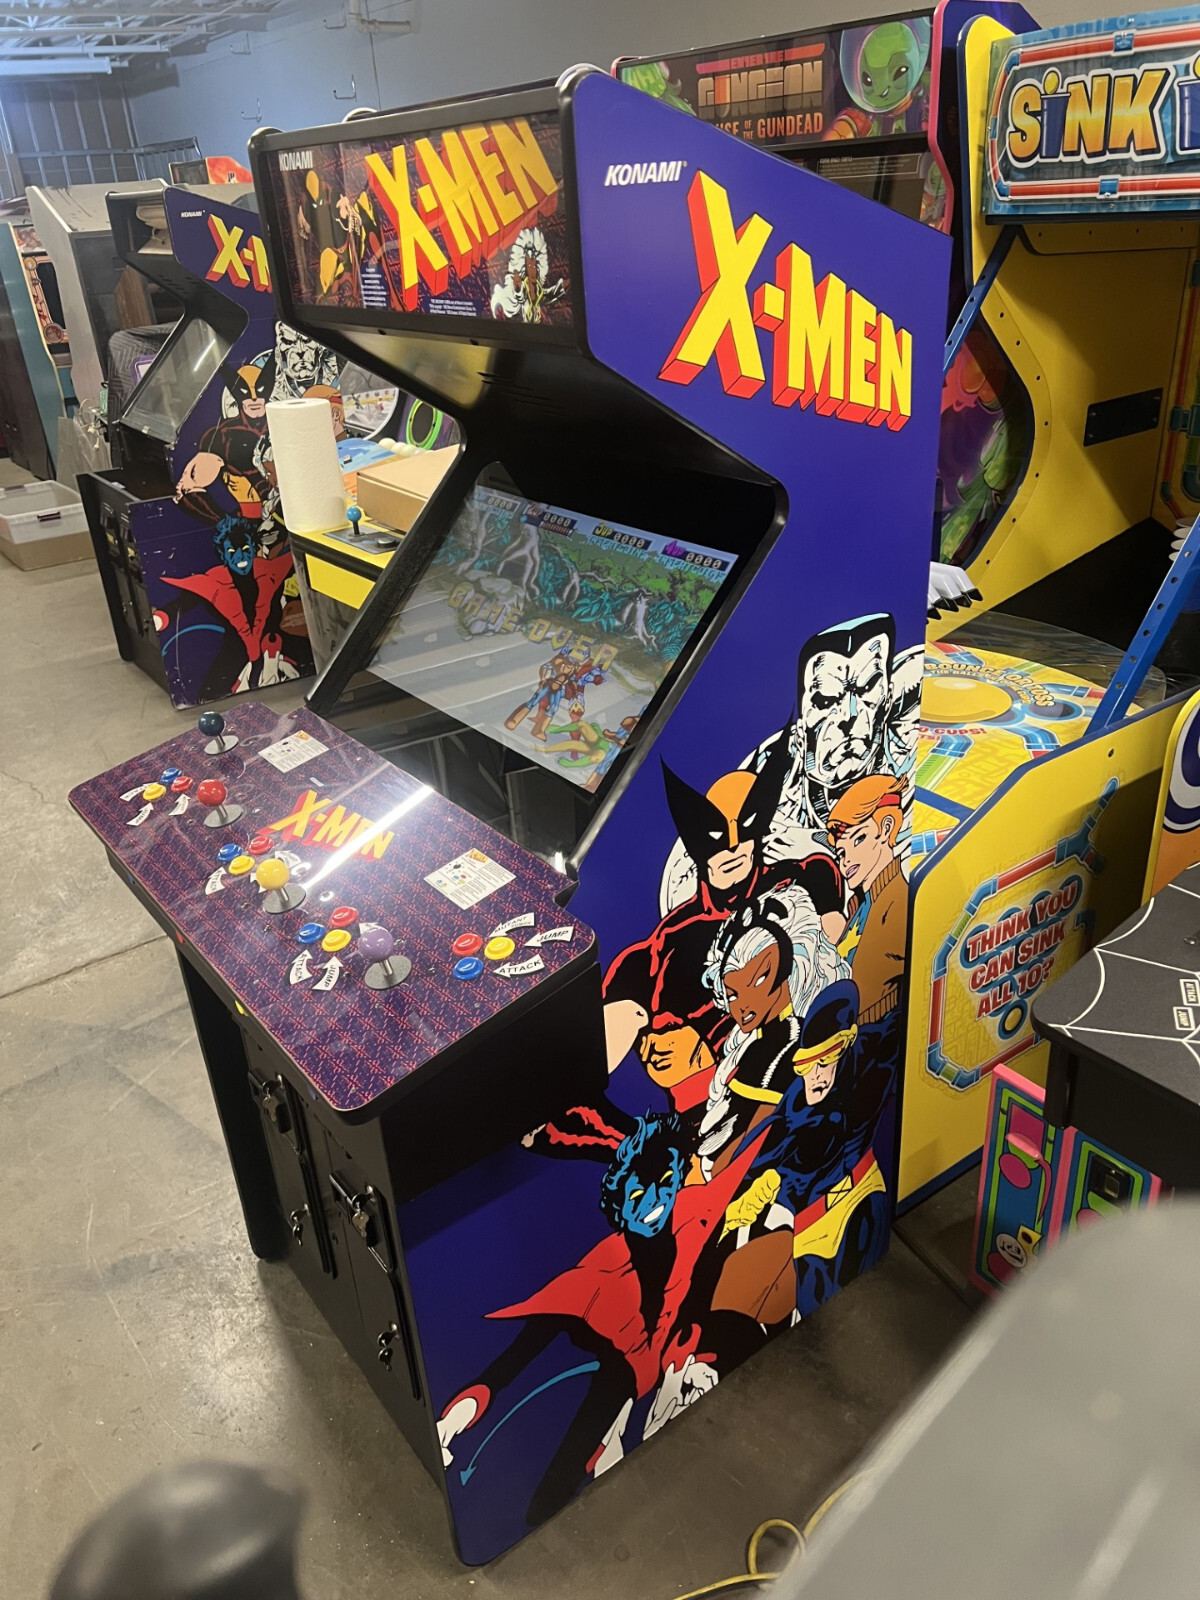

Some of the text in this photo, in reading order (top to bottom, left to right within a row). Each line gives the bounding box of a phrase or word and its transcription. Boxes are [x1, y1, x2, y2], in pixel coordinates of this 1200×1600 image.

[757, 112, 823, 139] GUNDEAD
[279, 150, 313, 172] KONAMI
[604, 161, 684, 187] KONAMI
[364, 116, 559, 308] X-MEN
[657, 168, 913, 433] X-MEN
[448, 585, 618, 672] GAME OVER
[924, 663, 1055, 707] BOUNCE OR TOSS
[934, 727, 988, 735] CUPS!
[537, 930, 569, 942] JUMP
[967, 881, 1078, 961] THINK YOU
[499, 959, 541, 974] ATTACK
[969, 920, 1066, 991] CAN SINK
[976, 956, 1055, 1020] ALL 10?
